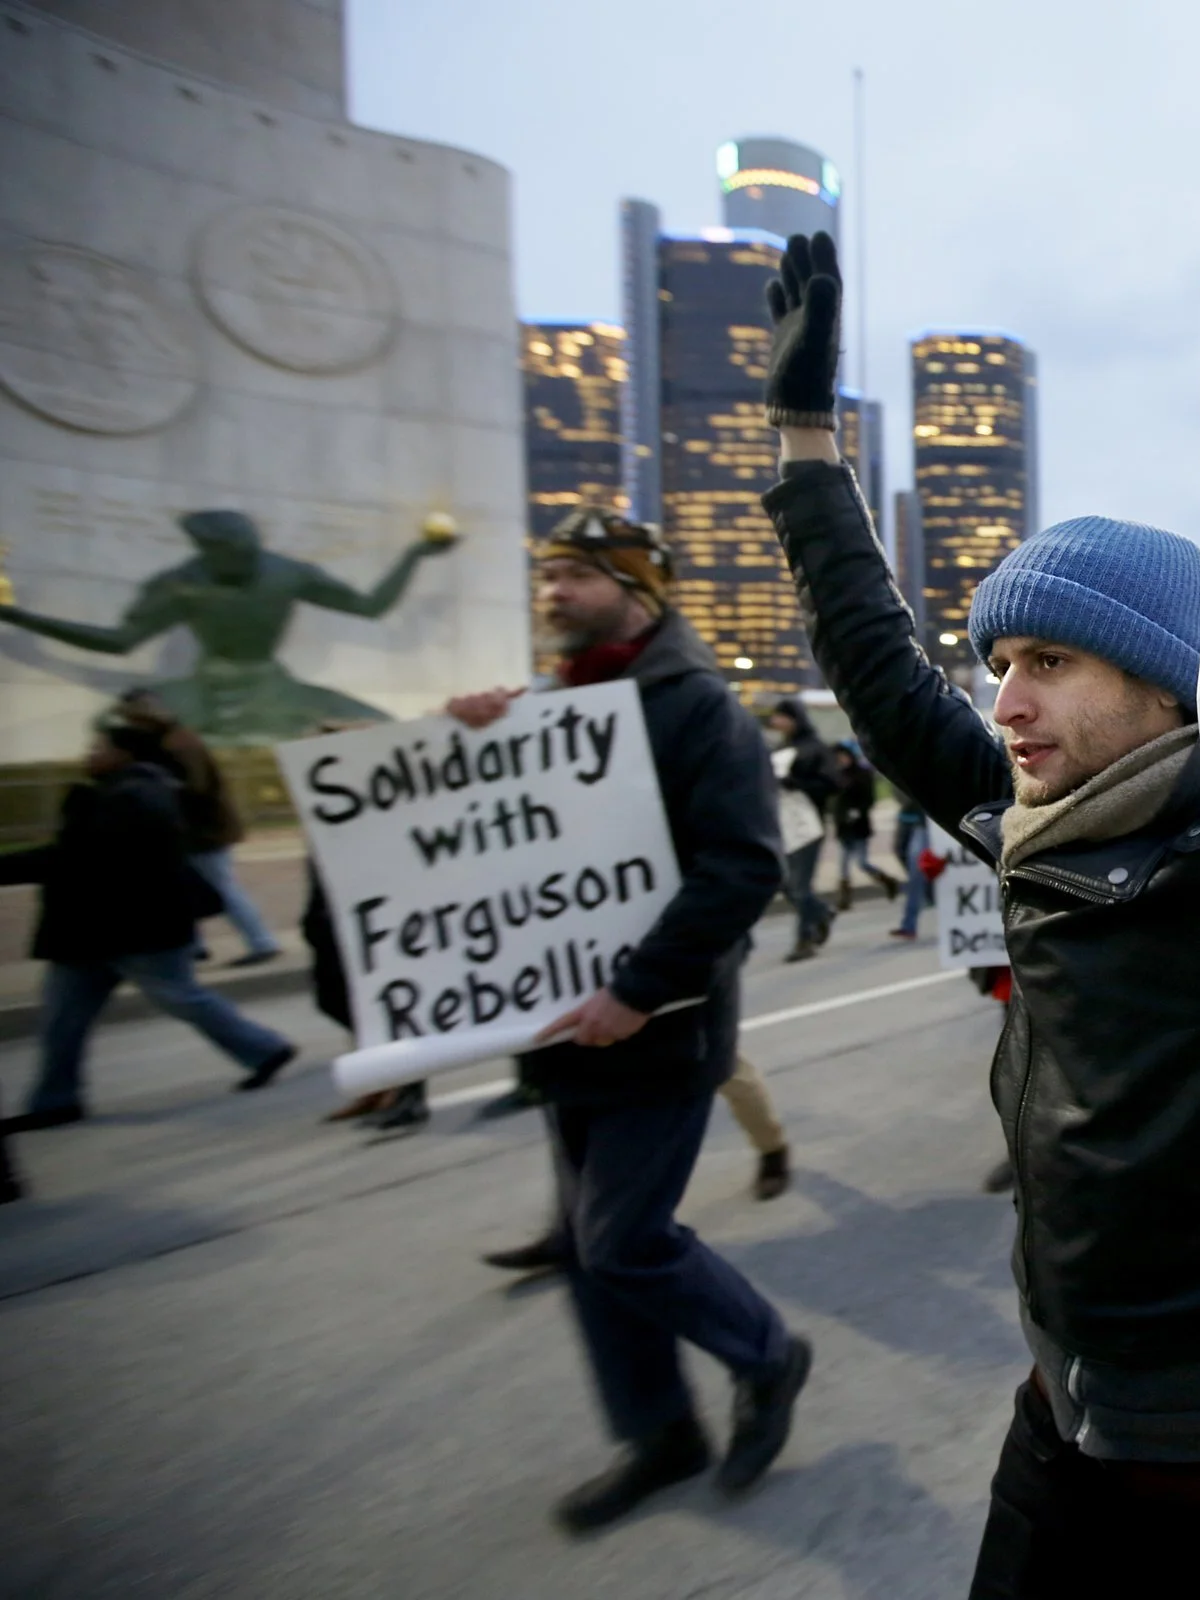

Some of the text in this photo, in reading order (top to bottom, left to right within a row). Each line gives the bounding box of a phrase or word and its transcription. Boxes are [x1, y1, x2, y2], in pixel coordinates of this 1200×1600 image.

[307, 704, 617, 826] Solidarity
[410, 794, 560, 868] with
[353, 857, 655, 974] Ferguson
